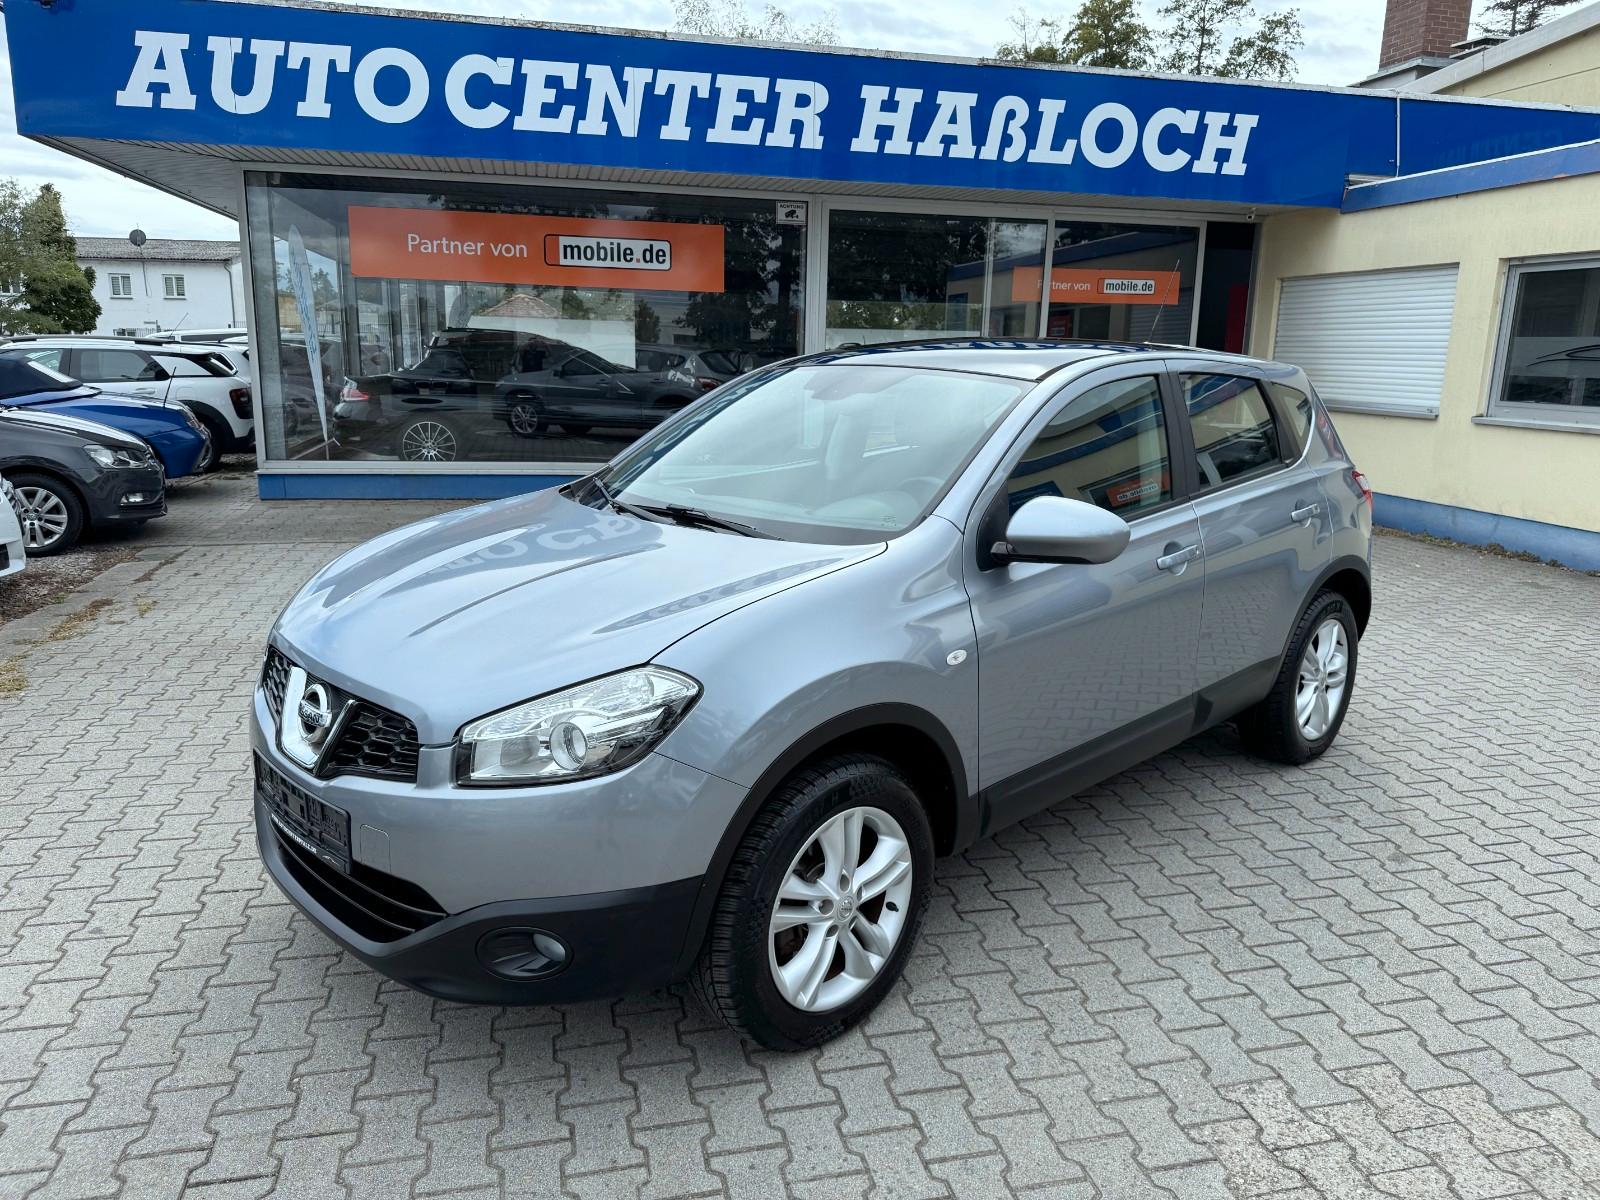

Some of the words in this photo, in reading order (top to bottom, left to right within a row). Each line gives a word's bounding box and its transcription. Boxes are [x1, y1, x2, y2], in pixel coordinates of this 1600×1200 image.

[116, 30, 429, 123] AUTO
[446, 54, 828, 149] CENTER
[850, 85, 1259, 175] HAßLOCH
[407, 234, 484, 256] Partner
[490, 241, 528, 258] von
[562, 241, 667, 265] mobile.de
[1037, 279, 1071, 290] Ptner
[1073, 282, 1090, 290] von
[1105, 280, 1153, 292] mobile.de
